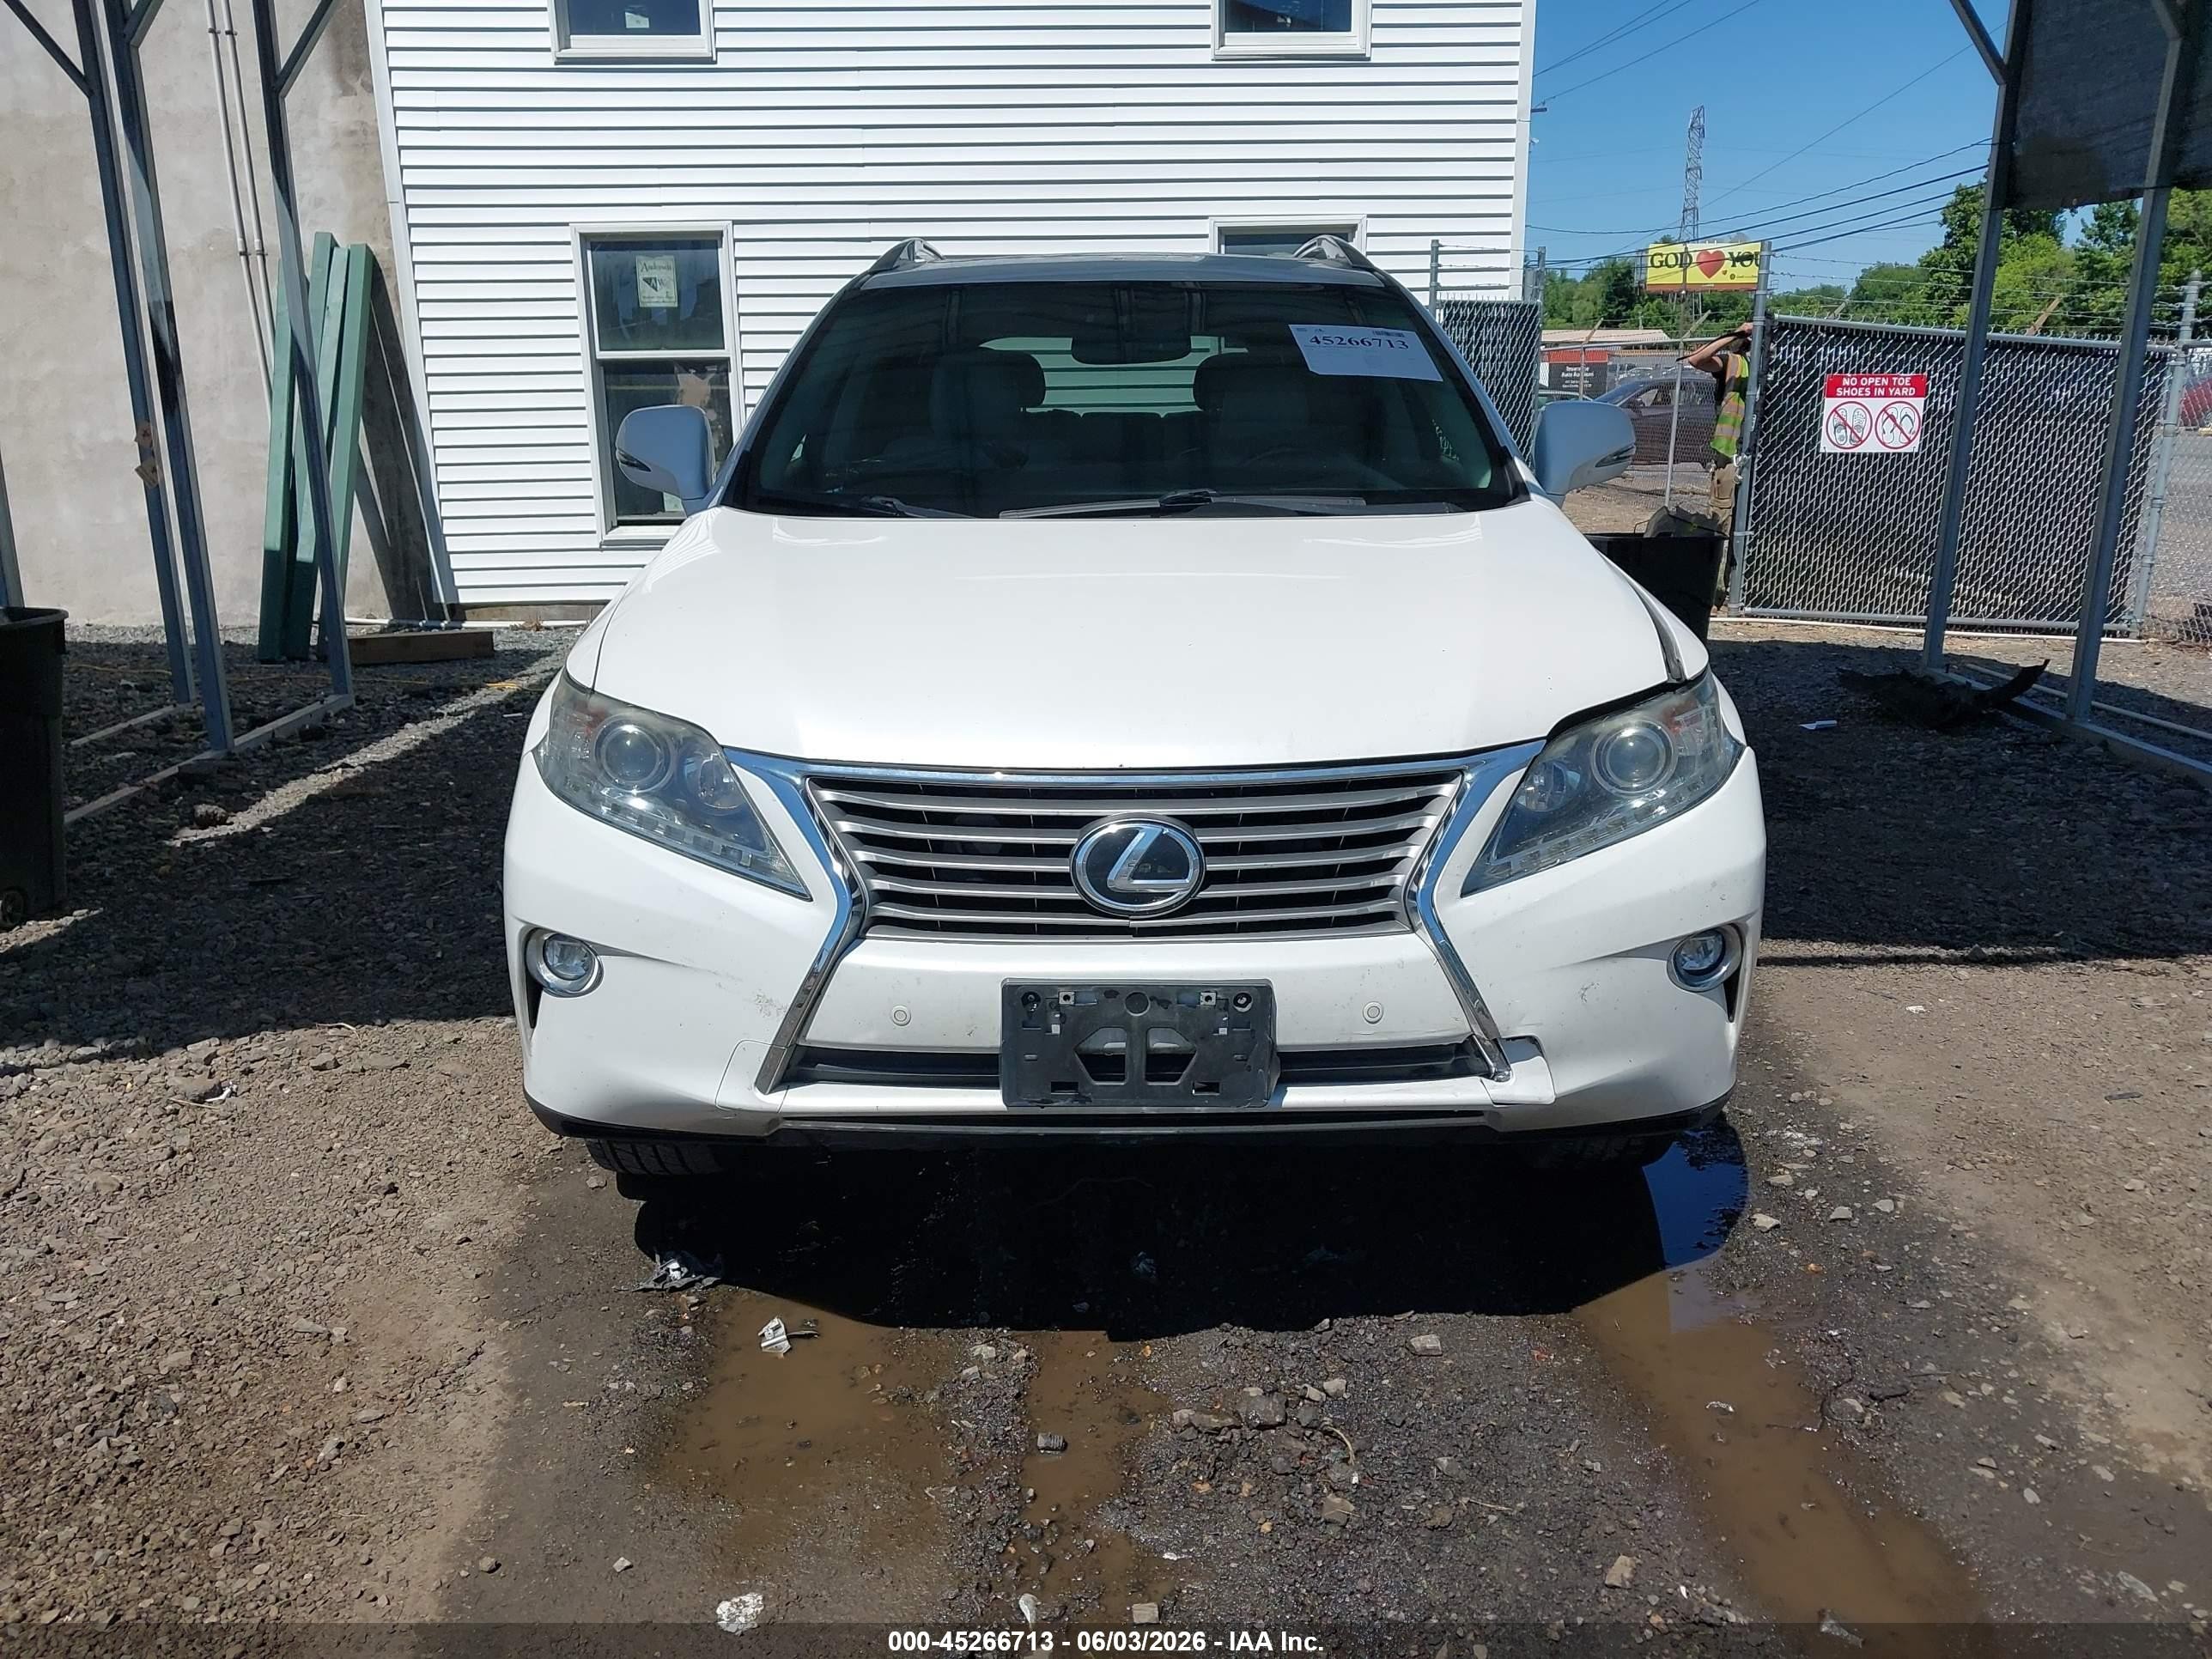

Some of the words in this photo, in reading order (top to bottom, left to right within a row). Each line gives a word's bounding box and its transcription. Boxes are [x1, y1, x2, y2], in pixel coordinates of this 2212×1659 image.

[1650, 252, 1692, 269] GOD
[1310, 336, 1409, 349] 45266713
[1843, 377, 1857, 386] NO
[1860, 377, 1888, 386] OPEN
[1892, 377, 1911, 386] TOE
[1836, 387, 1871, 397] SHOES
[1875, 388, 1885, 397] IN
[1888, 388, 1916, 397] YARD
